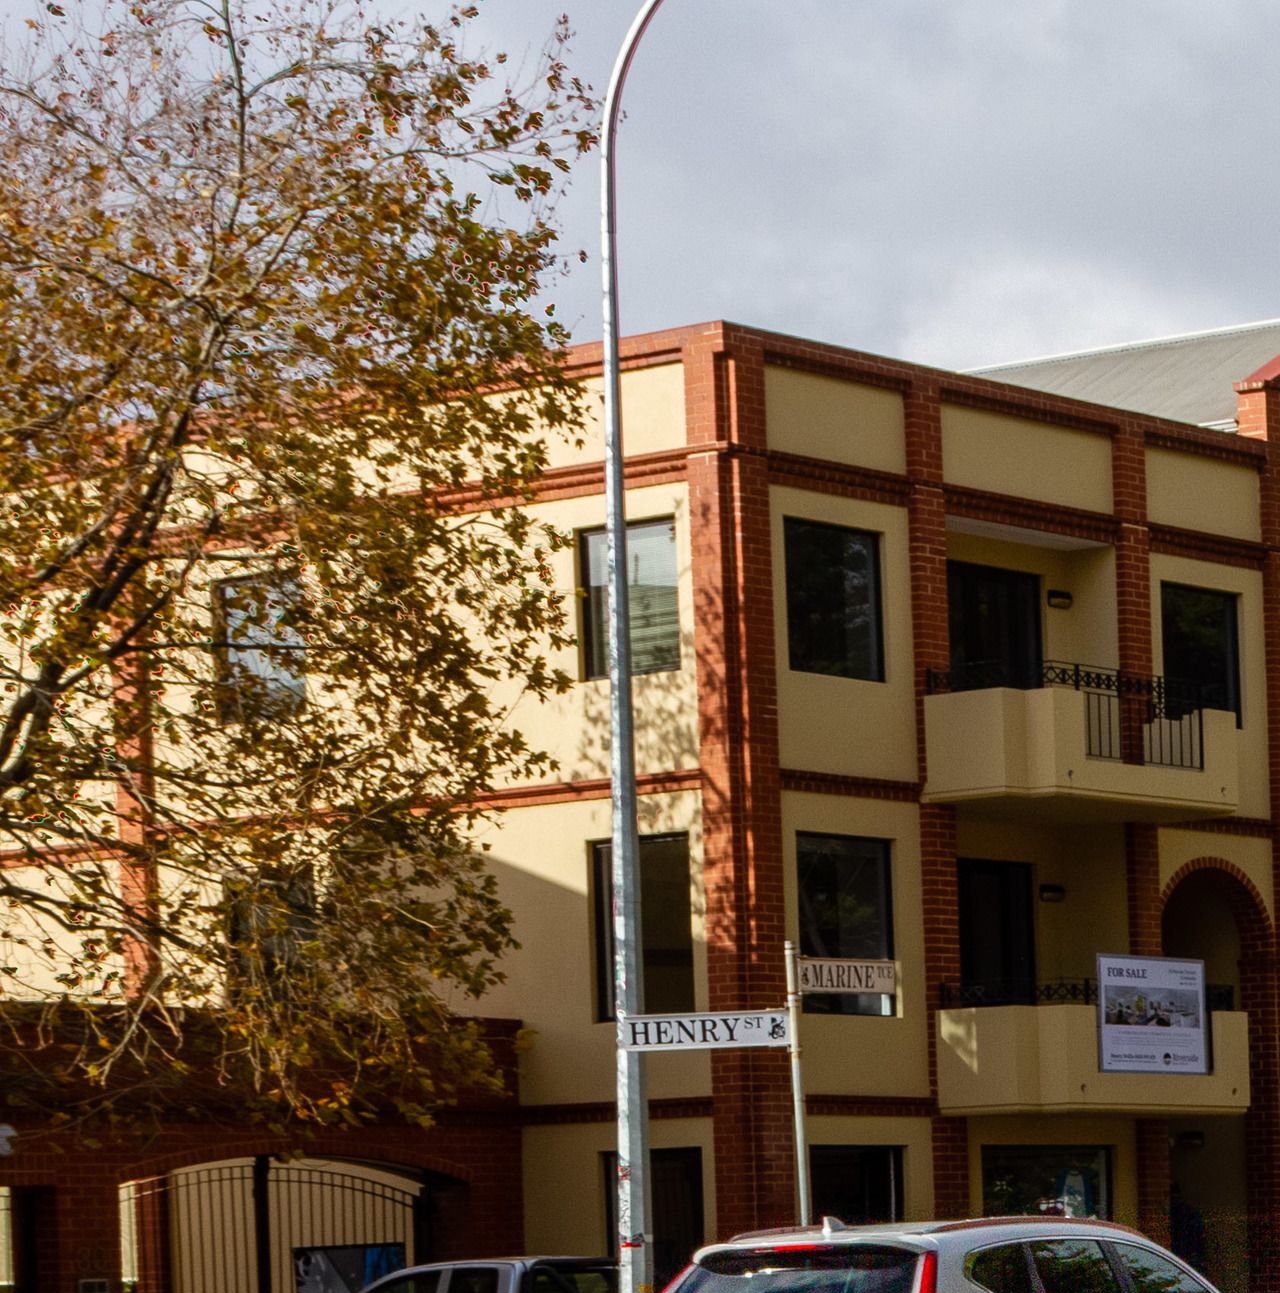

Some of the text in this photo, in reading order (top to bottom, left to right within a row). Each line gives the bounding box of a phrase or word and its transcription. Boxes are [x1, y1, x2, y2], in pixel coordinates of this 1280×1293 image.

[811, 963, 893, 989] MARINE TCE
[1107, 967, 1148, 979] FOR SALE
[630, 1017, 763, 1046] HENRY ST
